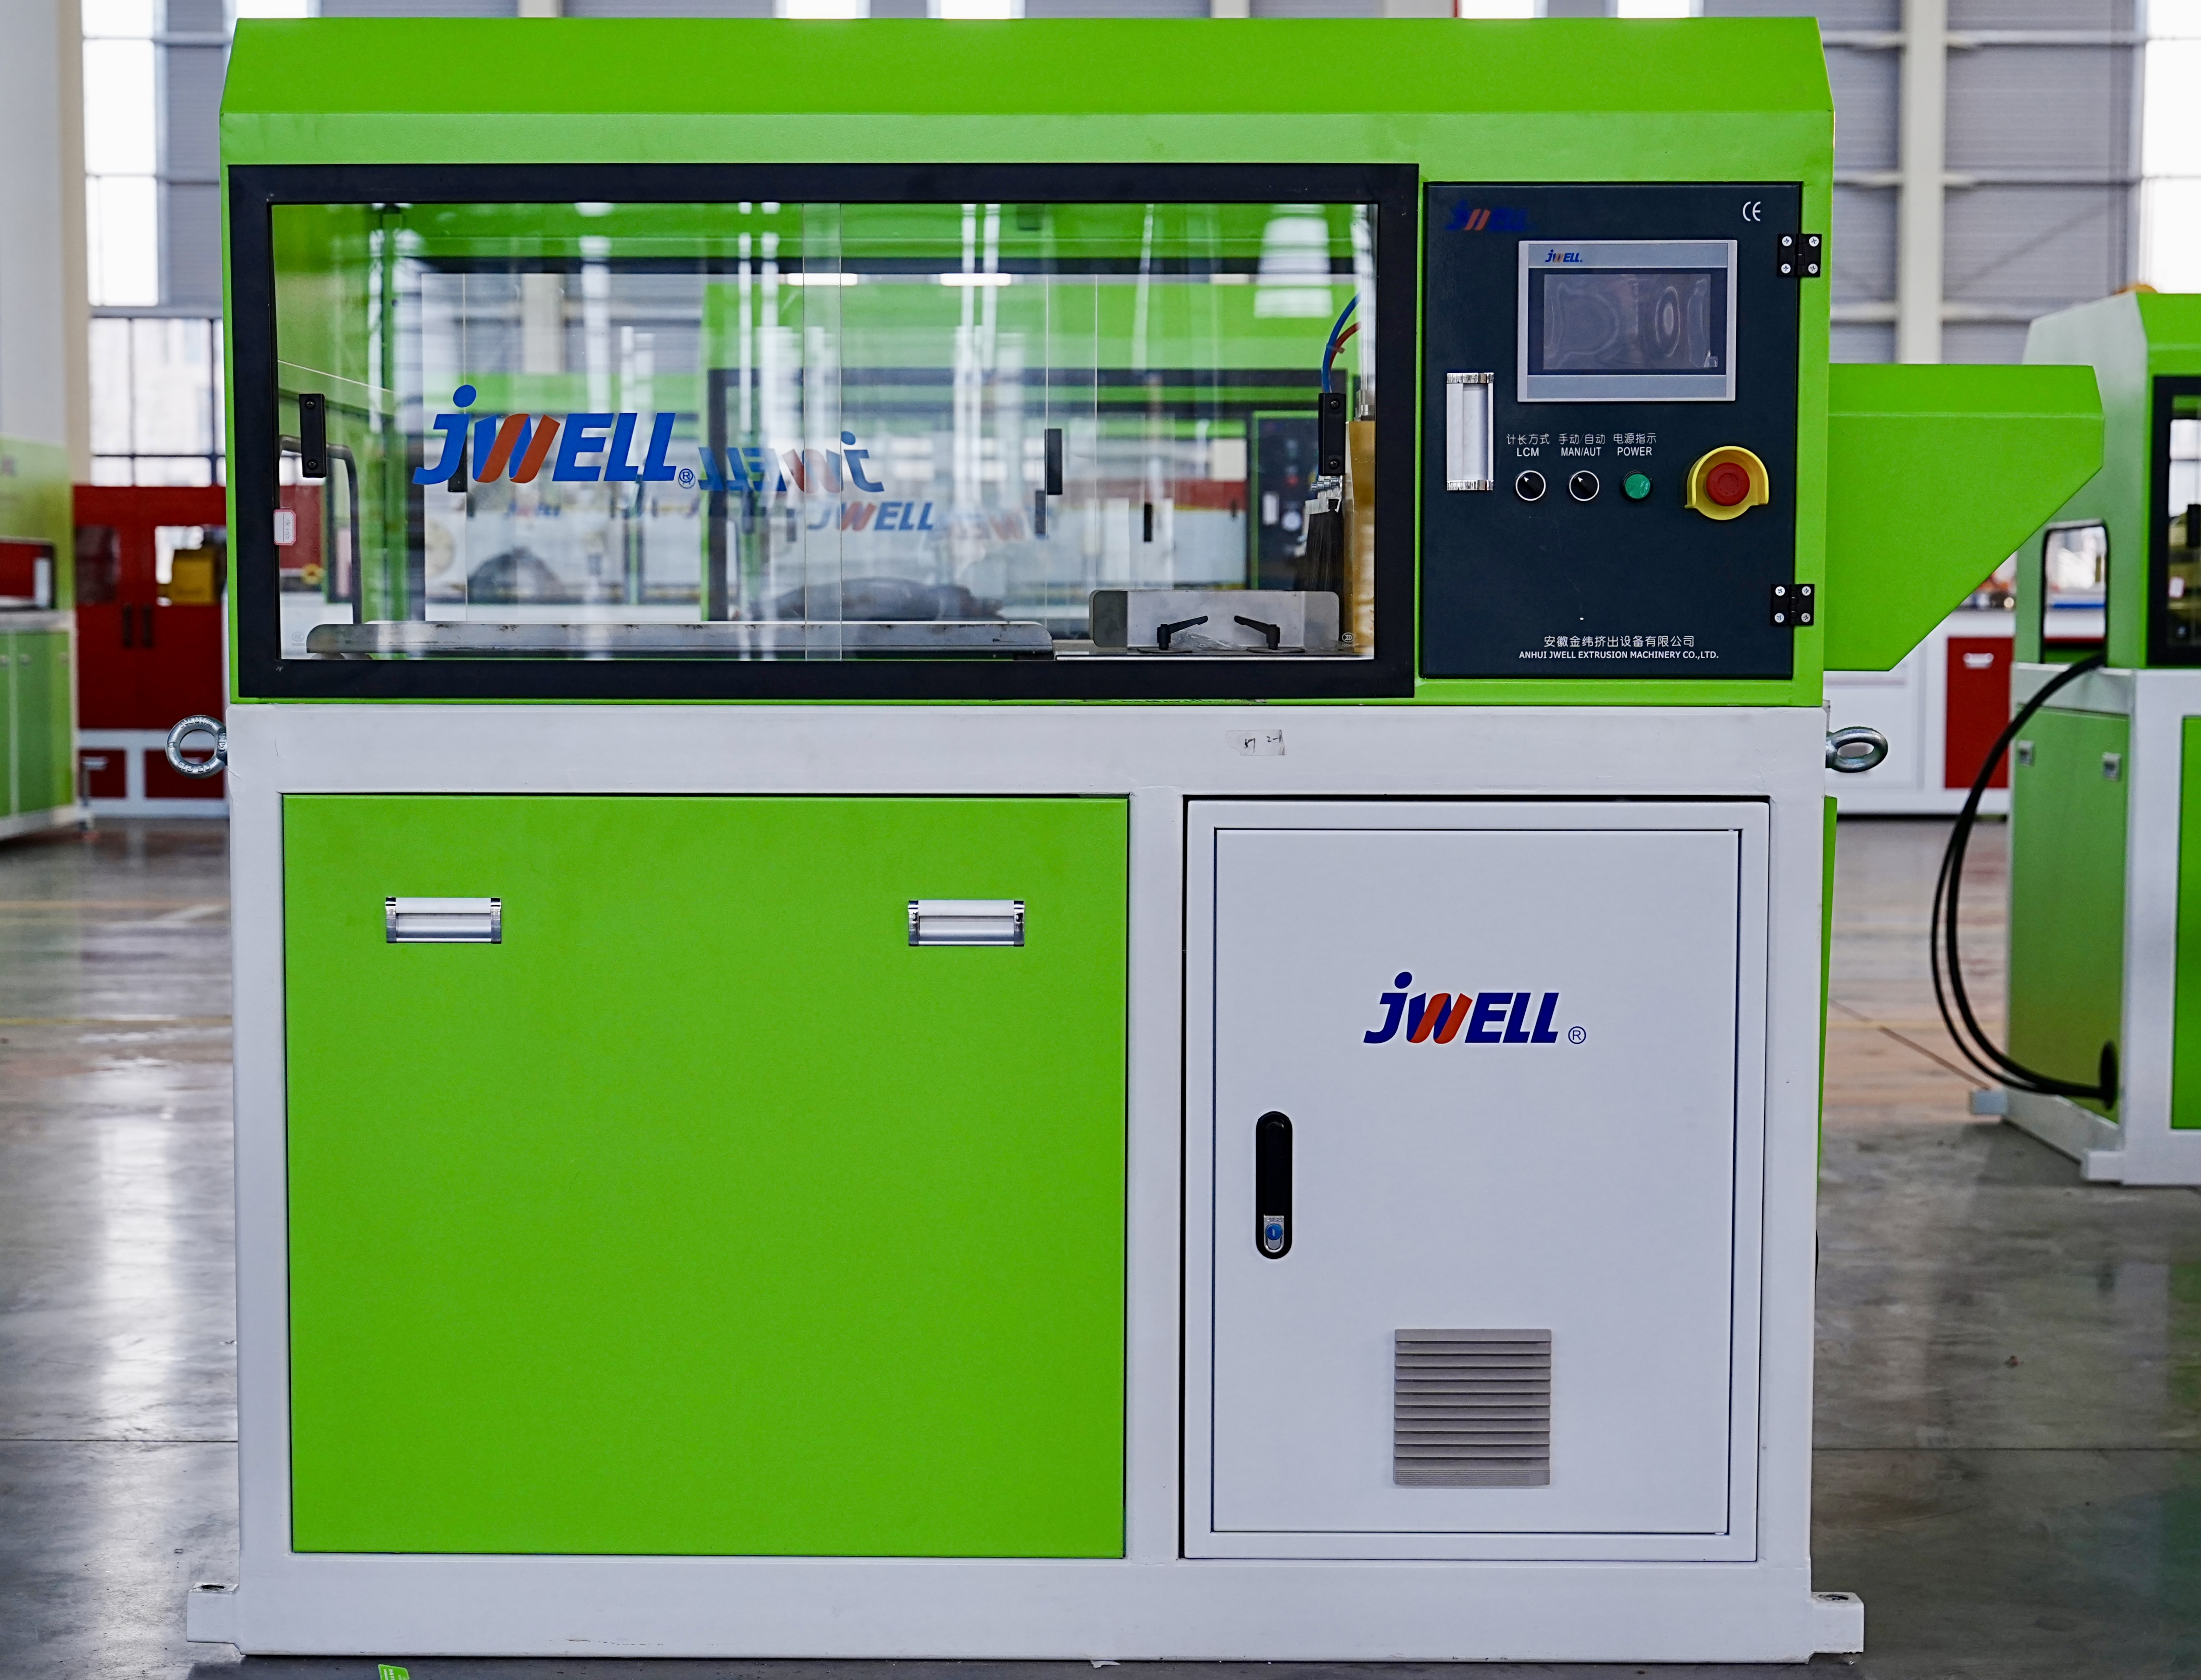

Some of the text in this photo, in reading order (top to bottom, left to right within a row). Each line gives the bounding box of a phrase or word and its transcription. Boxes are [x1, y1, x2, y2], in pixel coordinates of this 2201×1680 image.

[1743, 201, 1761, 222] CE
[1506, 433, 1550, 445] 计长方式
[1558, 433, 1605, 445] 手动/自动
[1613, 433, 1657, 444] 电源指示
[1517, 447, 1539, 457] LCM
[1561, 447, 1602, 457] MAN/AUT
[1617, 446, 1652, 456] POWER
[1543, 635, 1694, 648] 安徽金纬挤出设备有限公司
[1682, 651, 1719, 660] CO.,LTD.
